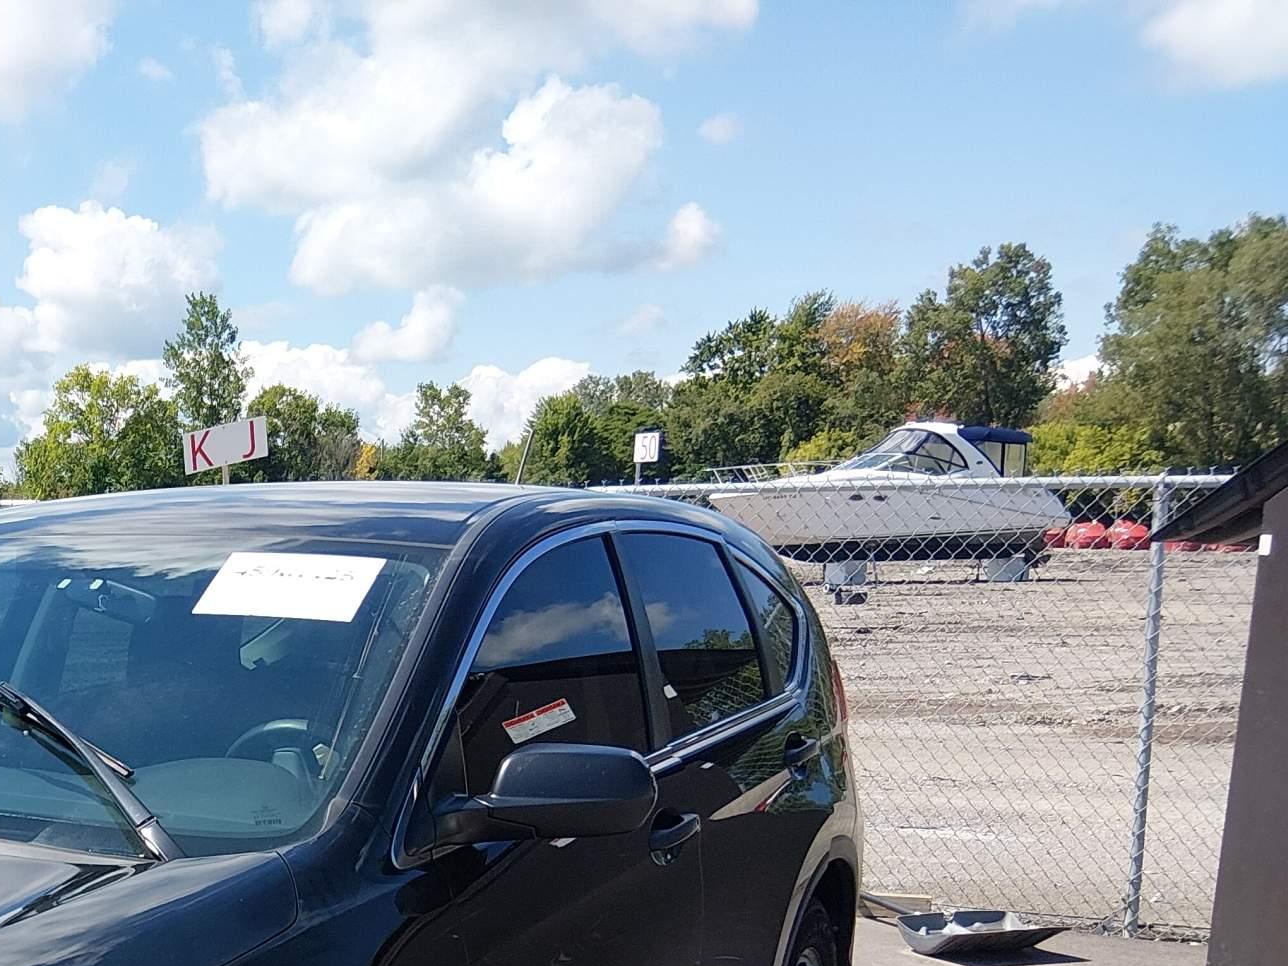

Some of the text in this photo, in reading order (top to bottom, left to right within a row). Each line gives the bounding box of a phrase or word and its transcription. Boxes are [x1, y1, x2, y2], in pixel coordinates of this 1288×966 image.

[190, 420, 256, 471] K J
[640, 435, 657, 461] 50
